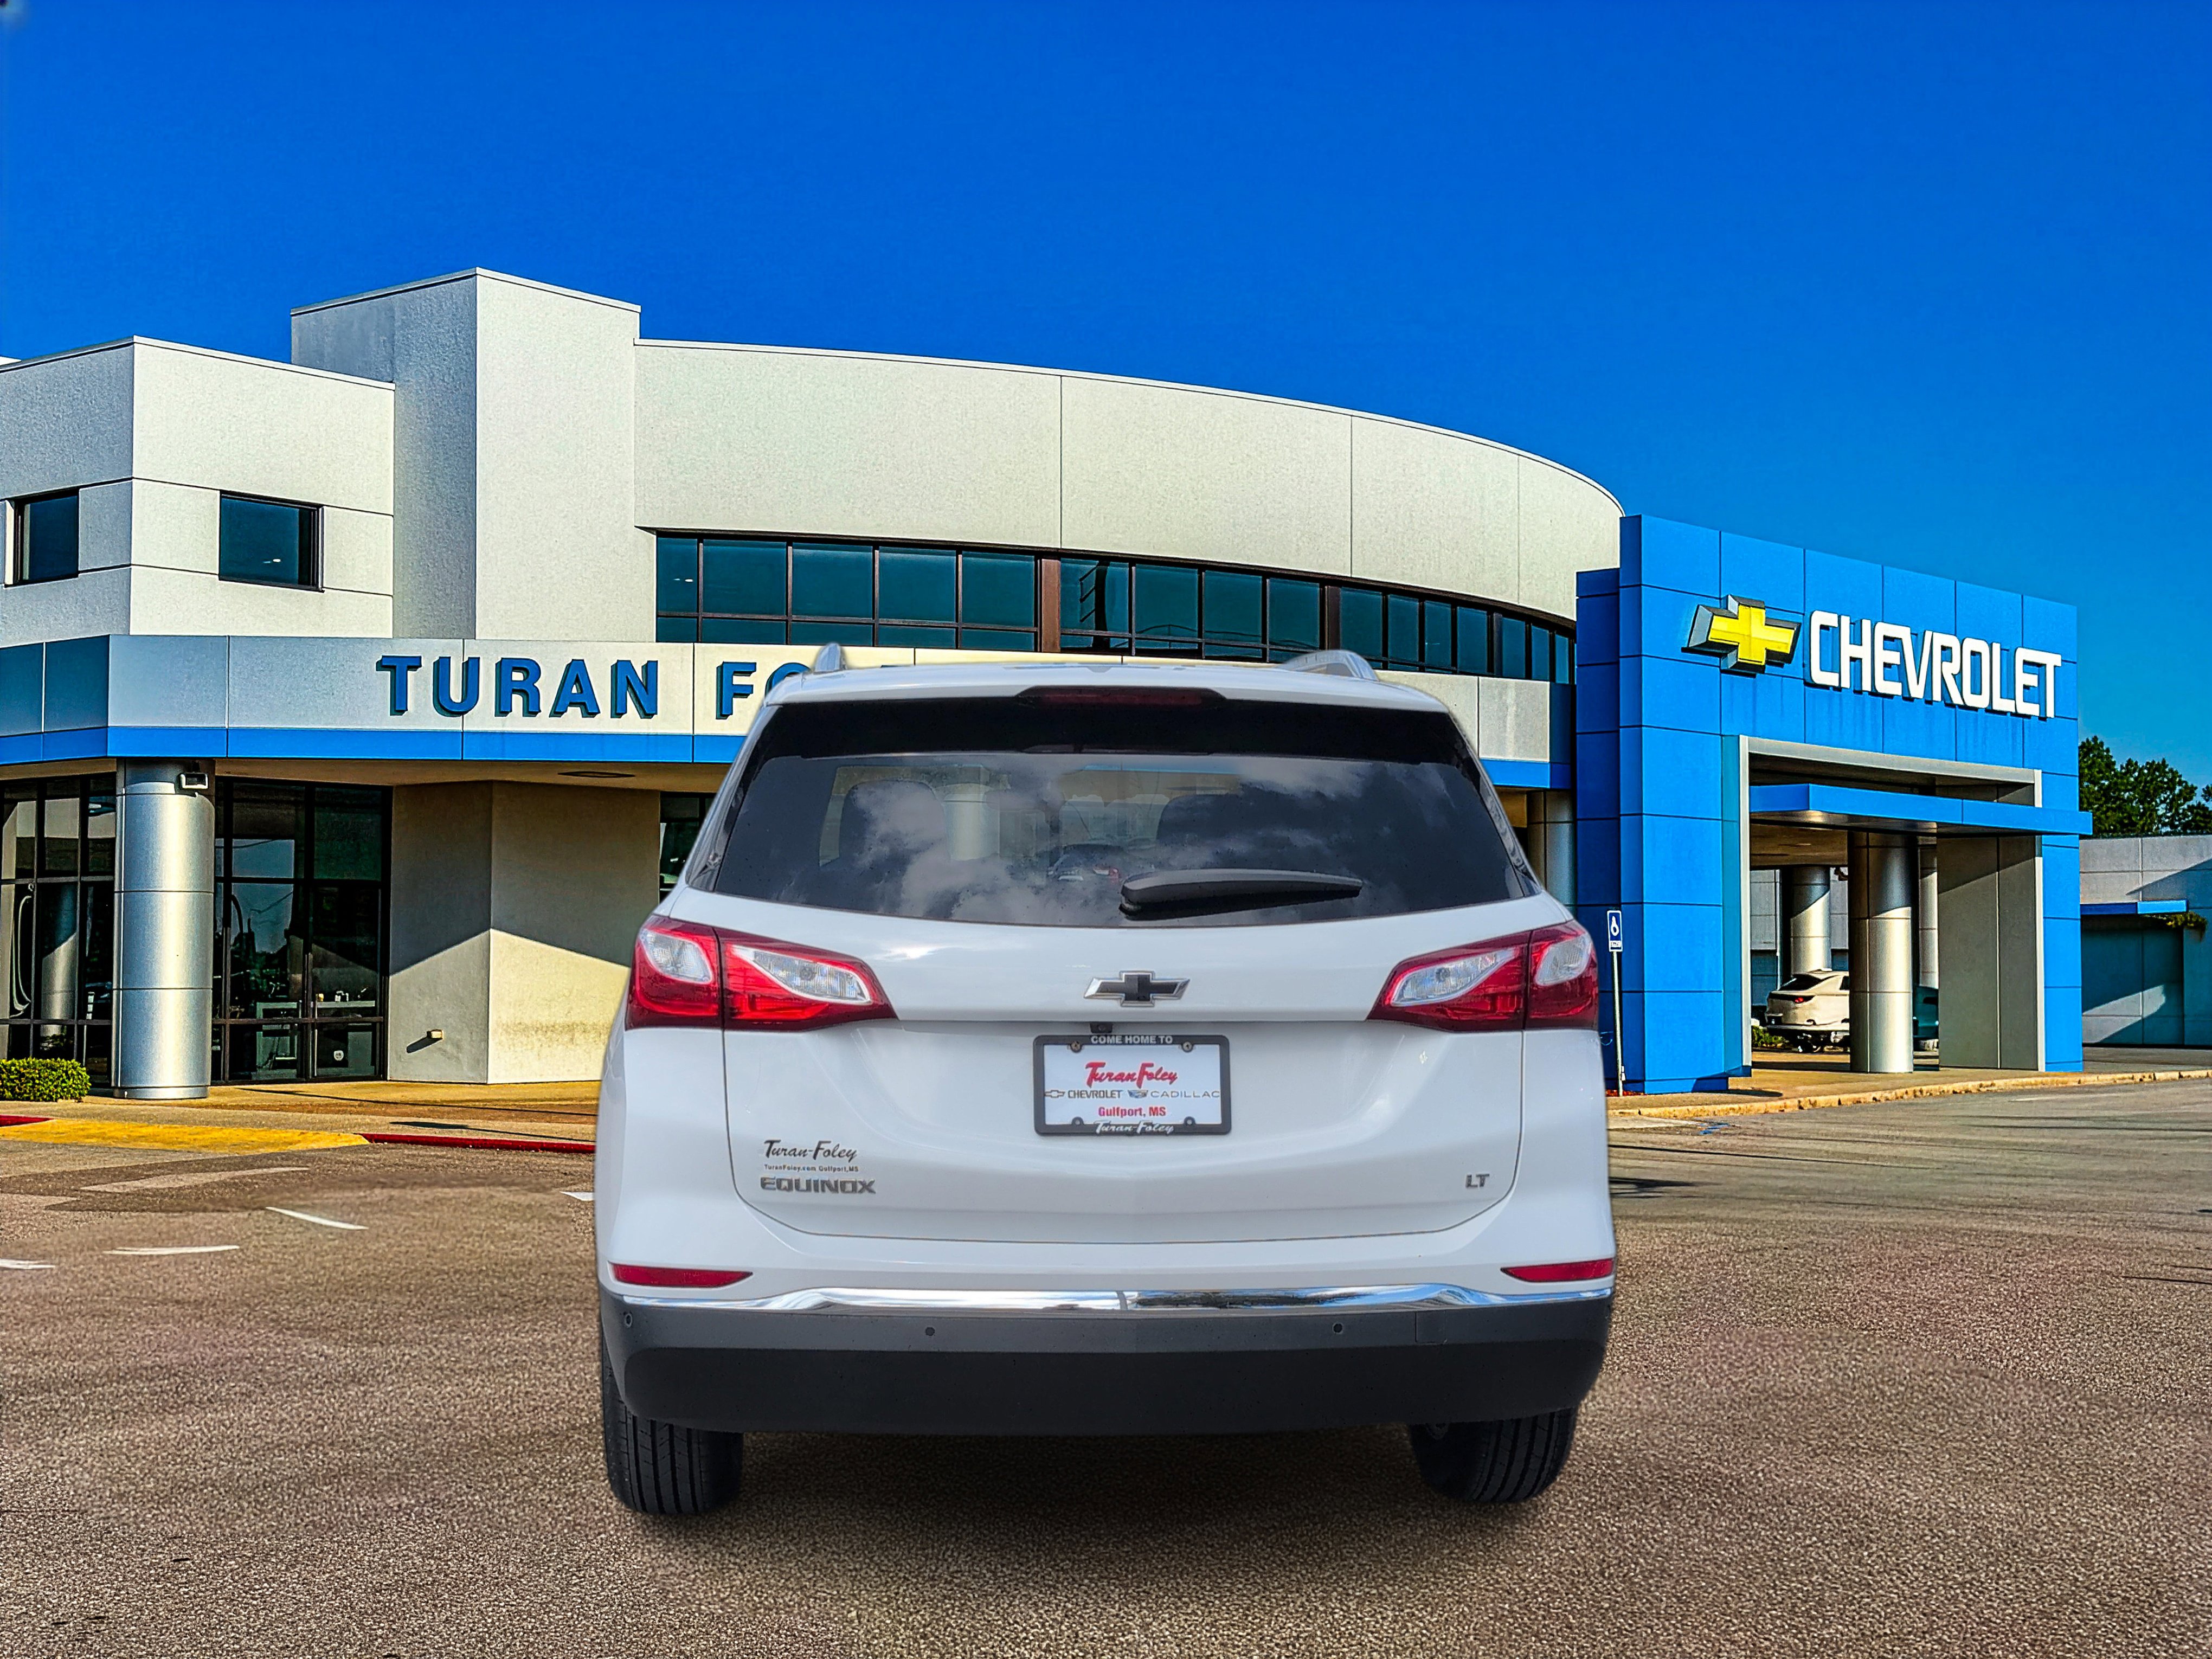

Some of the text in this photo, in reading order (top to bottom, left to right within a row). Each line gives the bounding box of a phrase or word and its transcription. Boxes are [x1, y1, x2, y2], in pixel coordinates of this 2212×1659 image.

[1810, 610, 2062, 718] CHEVROLET
[376, 655, 658, 719] TURAN
[1090, 1036, 1173, 1044] COME HOME TO
[1068, 1090, 1220, 1098] CHEVROLET CADILLAC
[1098, 1106, 1166, 1118] Gulfport, MS
[760, 1176, 877, 1194] EQUINOX
[1465, 1173, 1490, 1188] LT
